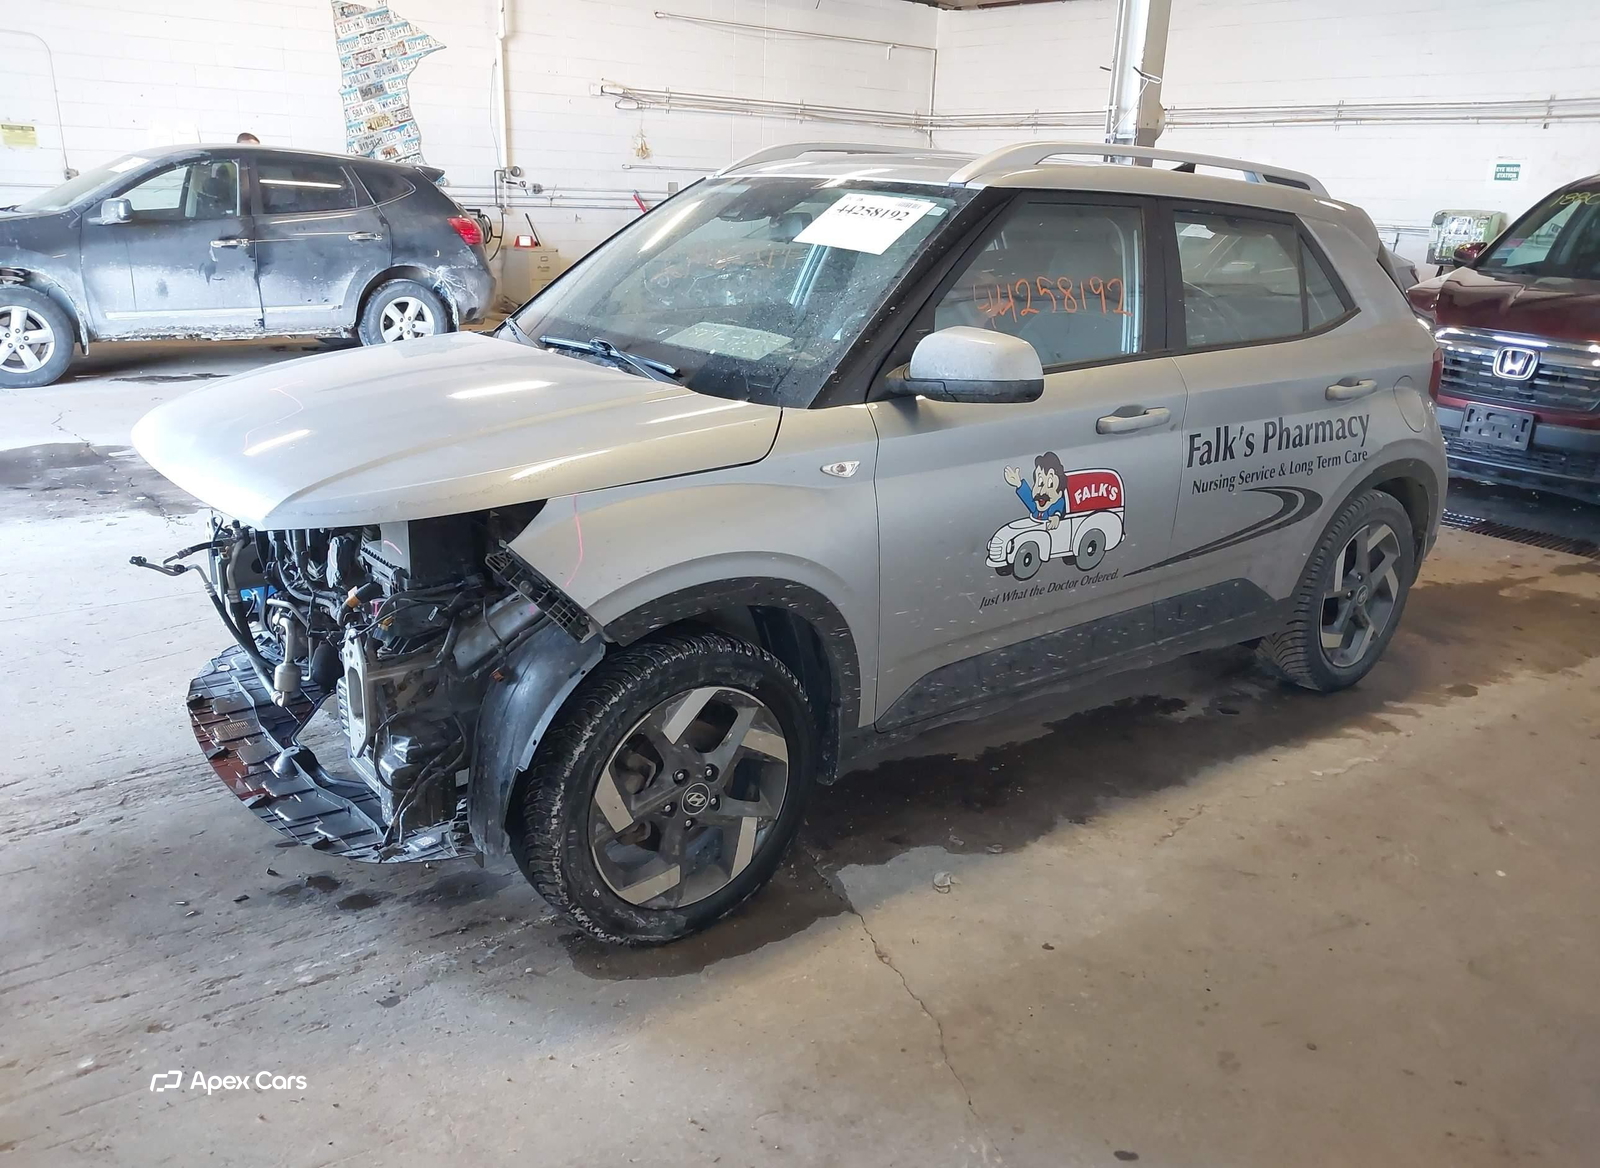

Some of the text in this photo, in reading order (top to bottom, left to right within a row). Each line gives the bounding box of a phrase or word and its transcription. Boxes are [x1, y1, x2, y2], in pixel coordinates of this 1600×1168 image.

[837, 204, 910, 222] 44258192
[1187, 414, 1370, 468] Falk's Pharmacy
[1192, 449, 1368, 495] Nursing Service & Long Term Care
[1074, 482, 1118, 505] FALK'S
[979, 568, 1119, 609] Just What the Doctor Ordered.
